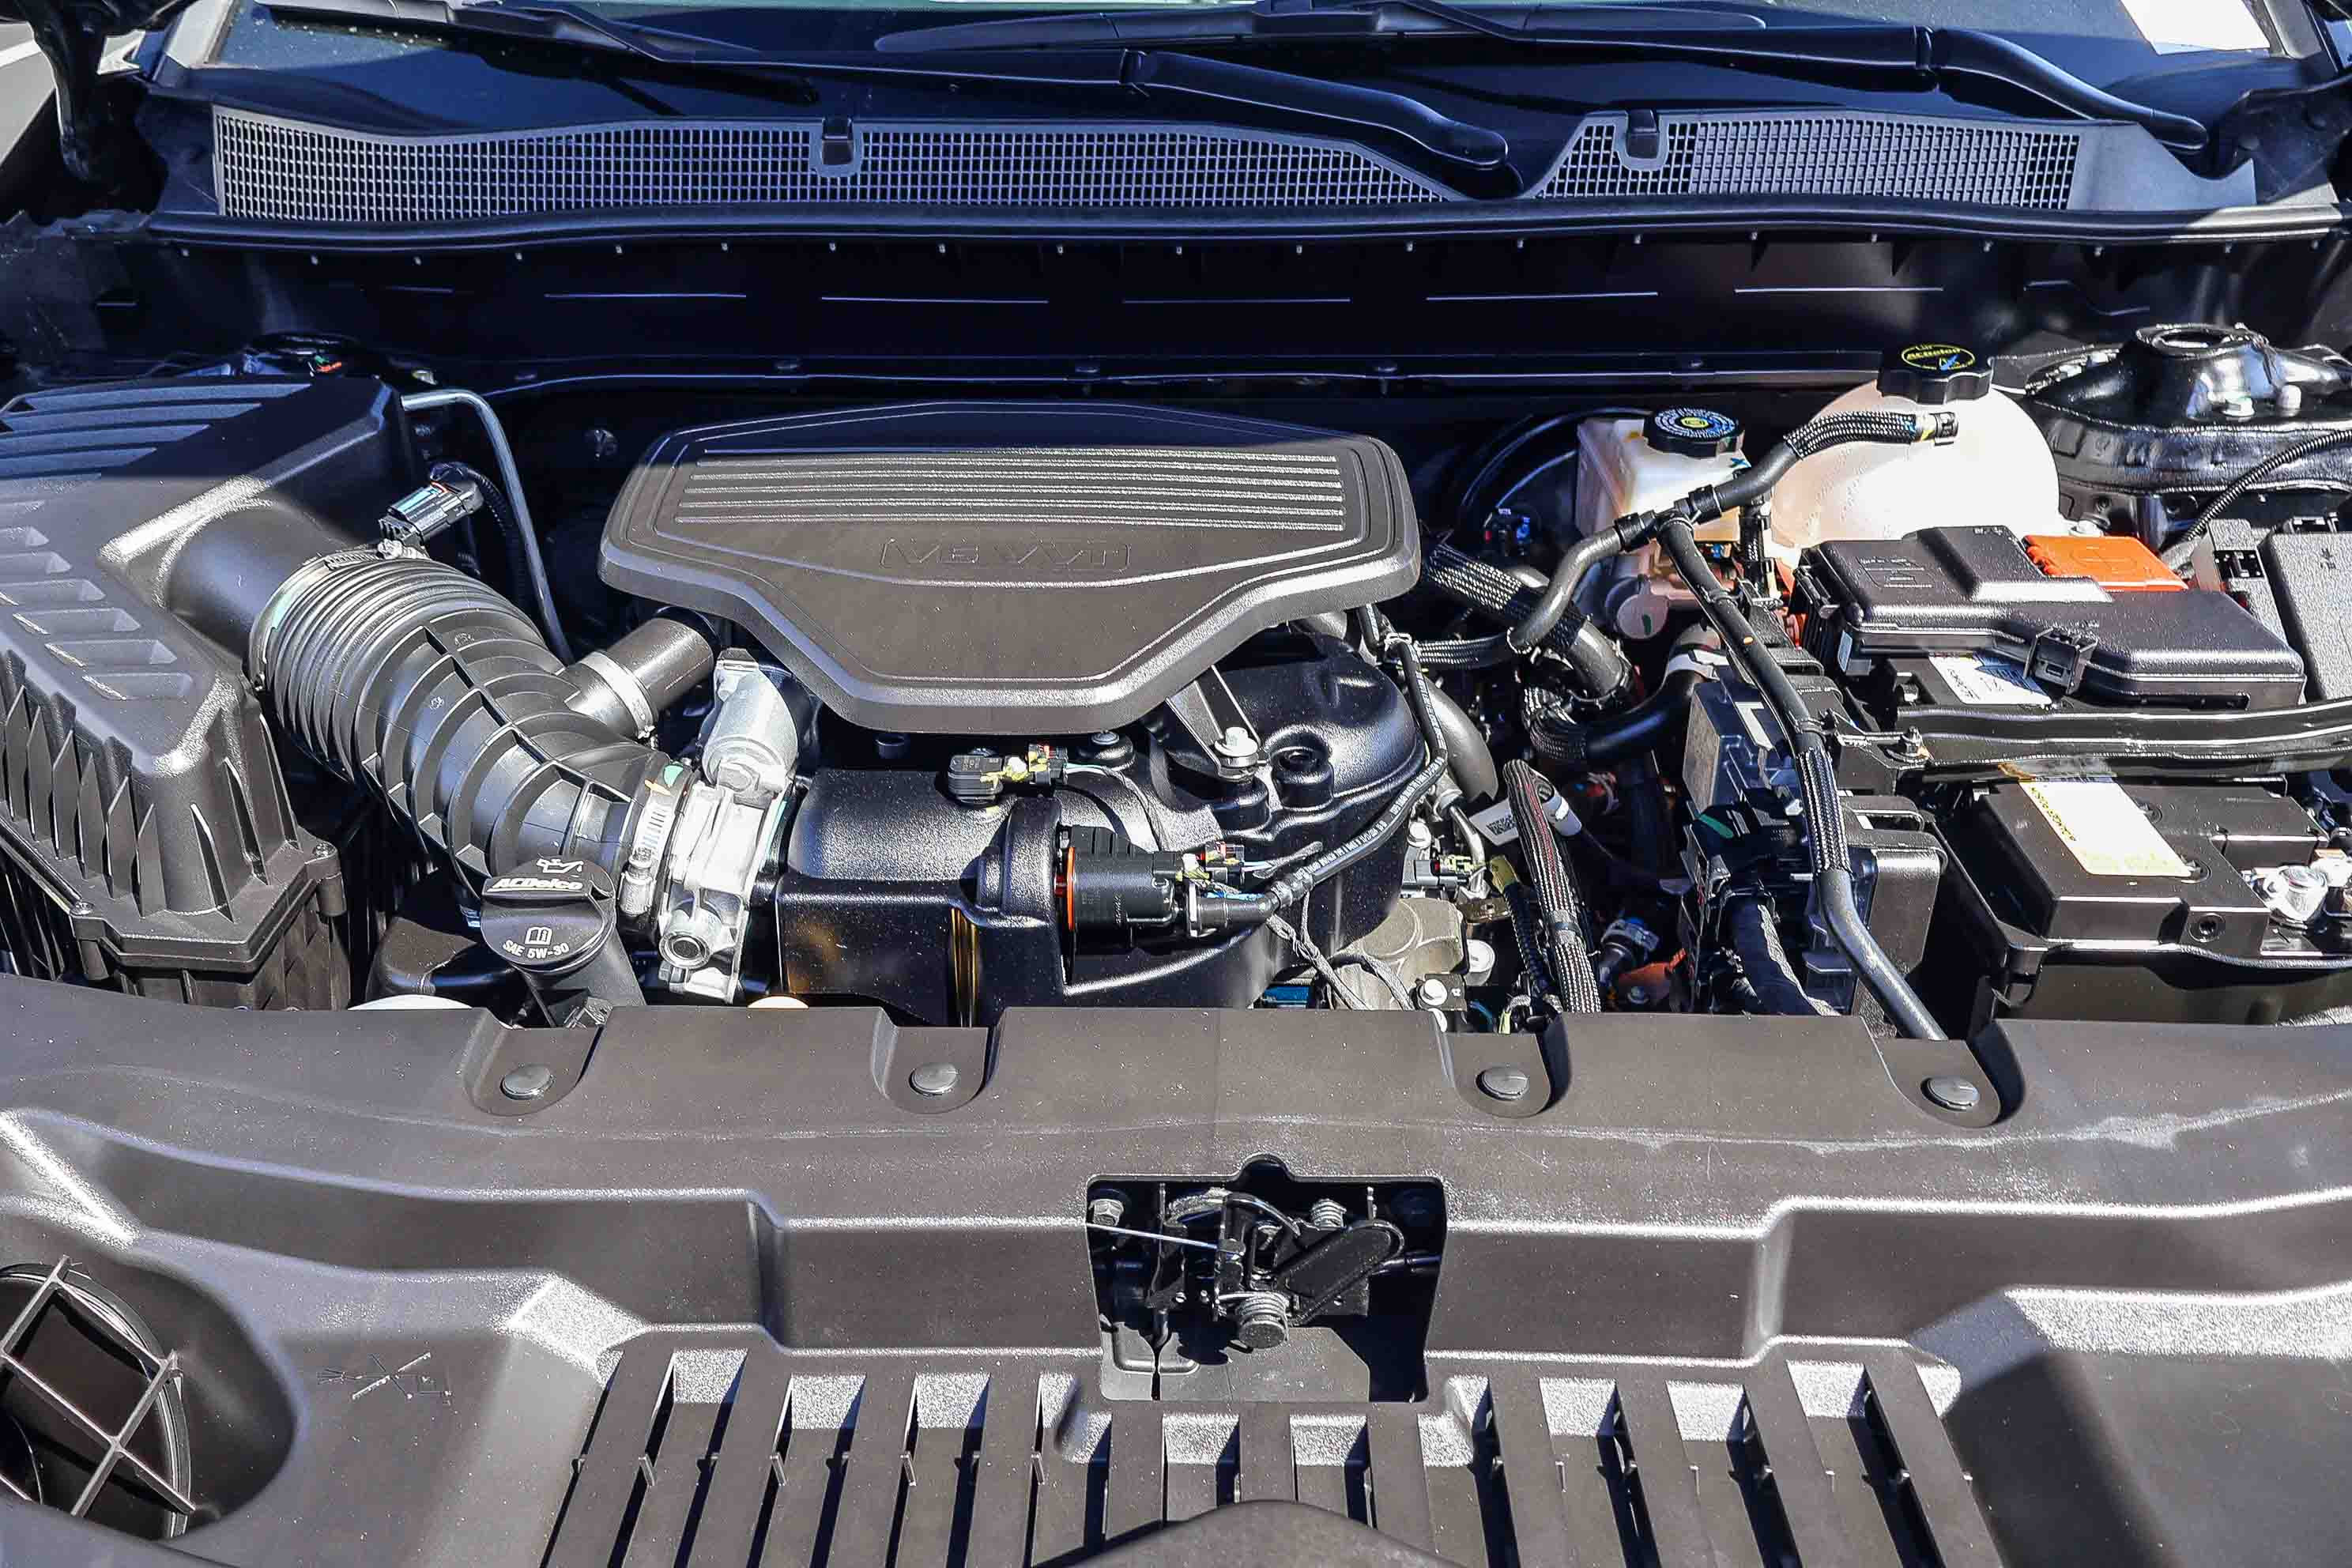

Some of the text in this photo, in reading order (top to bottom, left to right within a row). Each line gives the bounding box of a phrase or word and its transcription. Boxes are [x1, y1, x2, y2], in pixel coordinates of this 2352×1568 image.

[492, 877, 583, 891] ACDelco
[503, 939, 570, 959] SAE 5W-30
